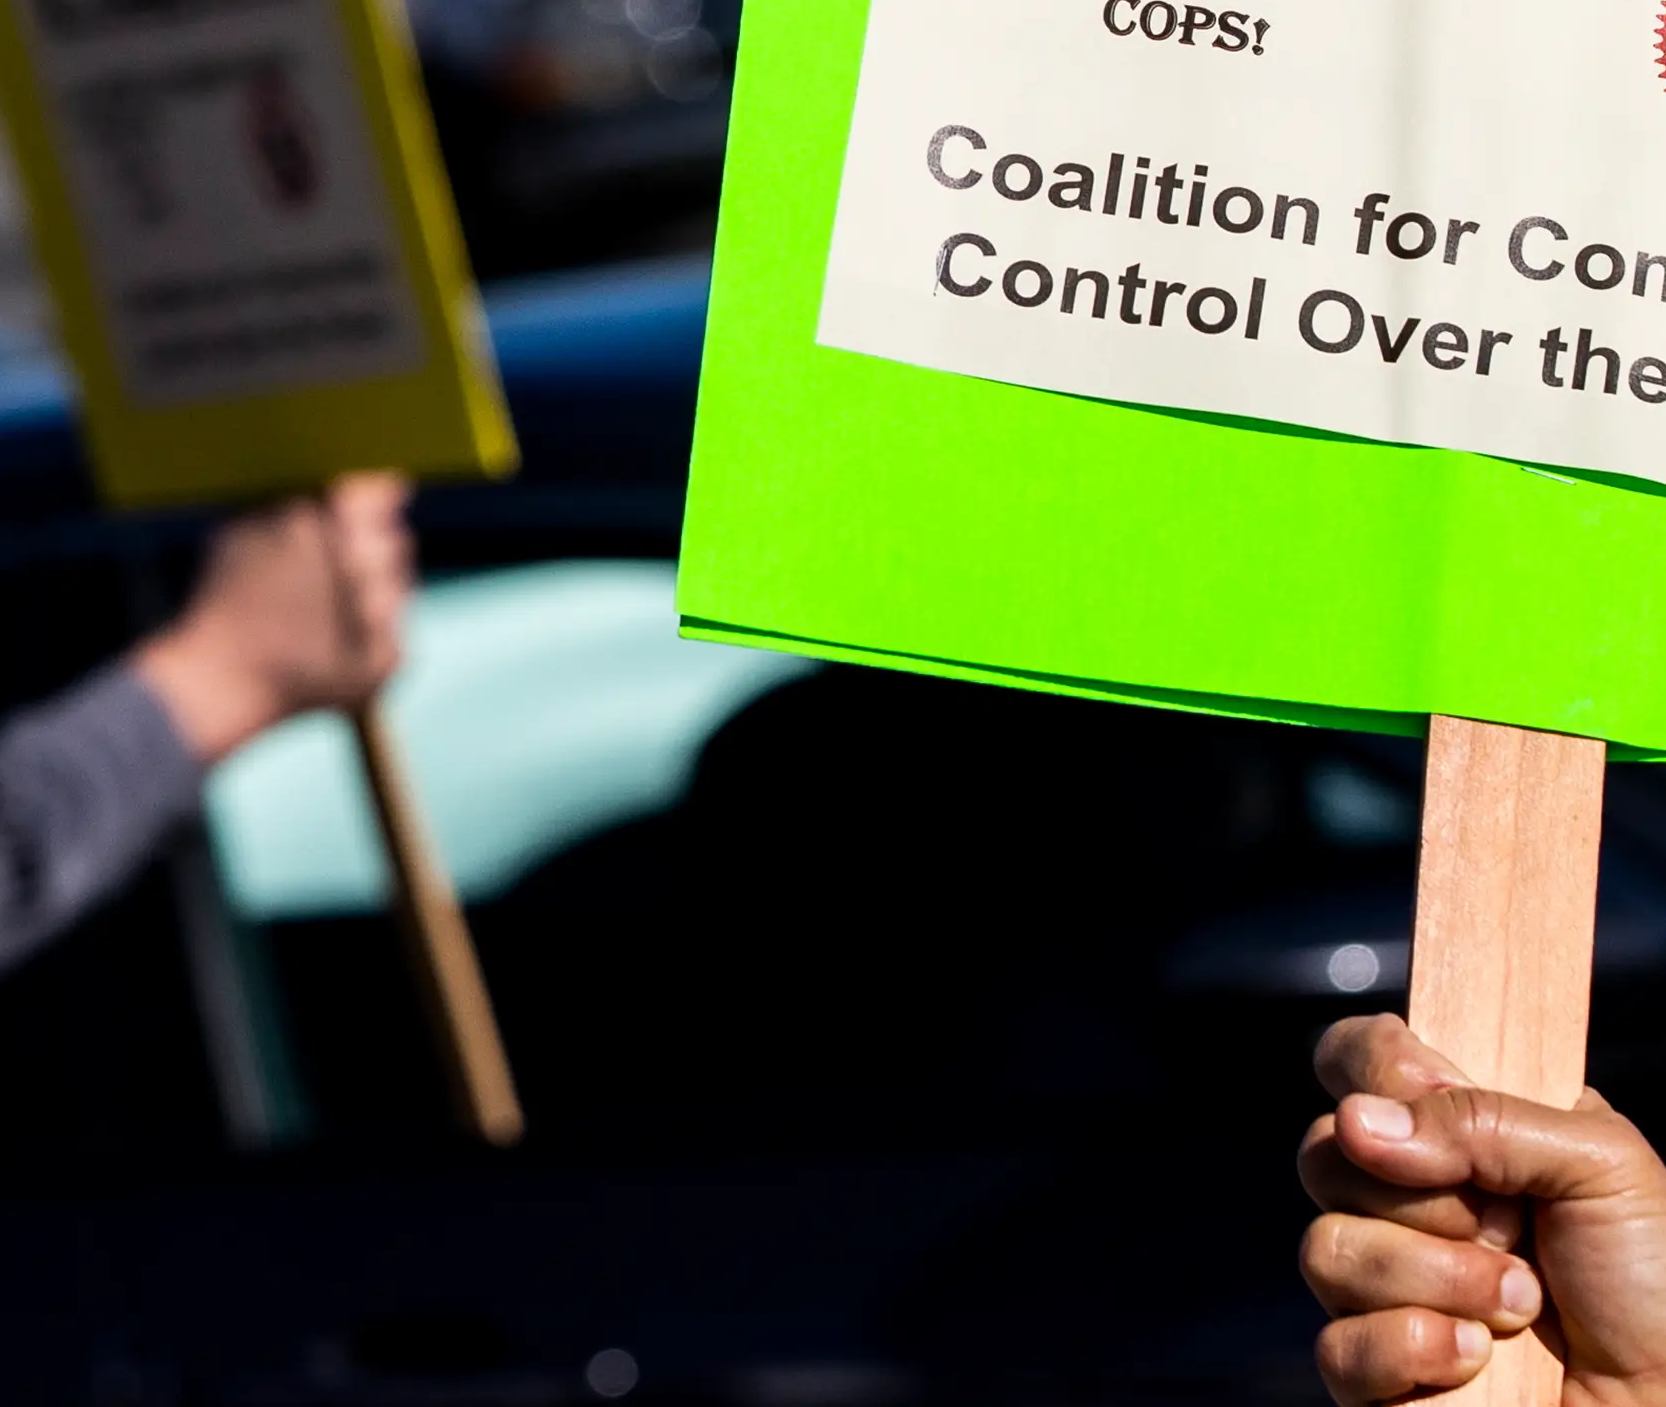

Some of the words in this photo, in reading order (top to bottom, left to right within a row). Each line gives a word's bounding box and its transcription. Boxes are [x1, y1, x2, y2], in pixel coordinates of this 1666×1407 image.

[925, 124, 1320, 247] Coalition
[1353, 192, 1481, 267] for
[936, 232, 1267, 342] Control
[1297, 288, 1514, 376] Over
